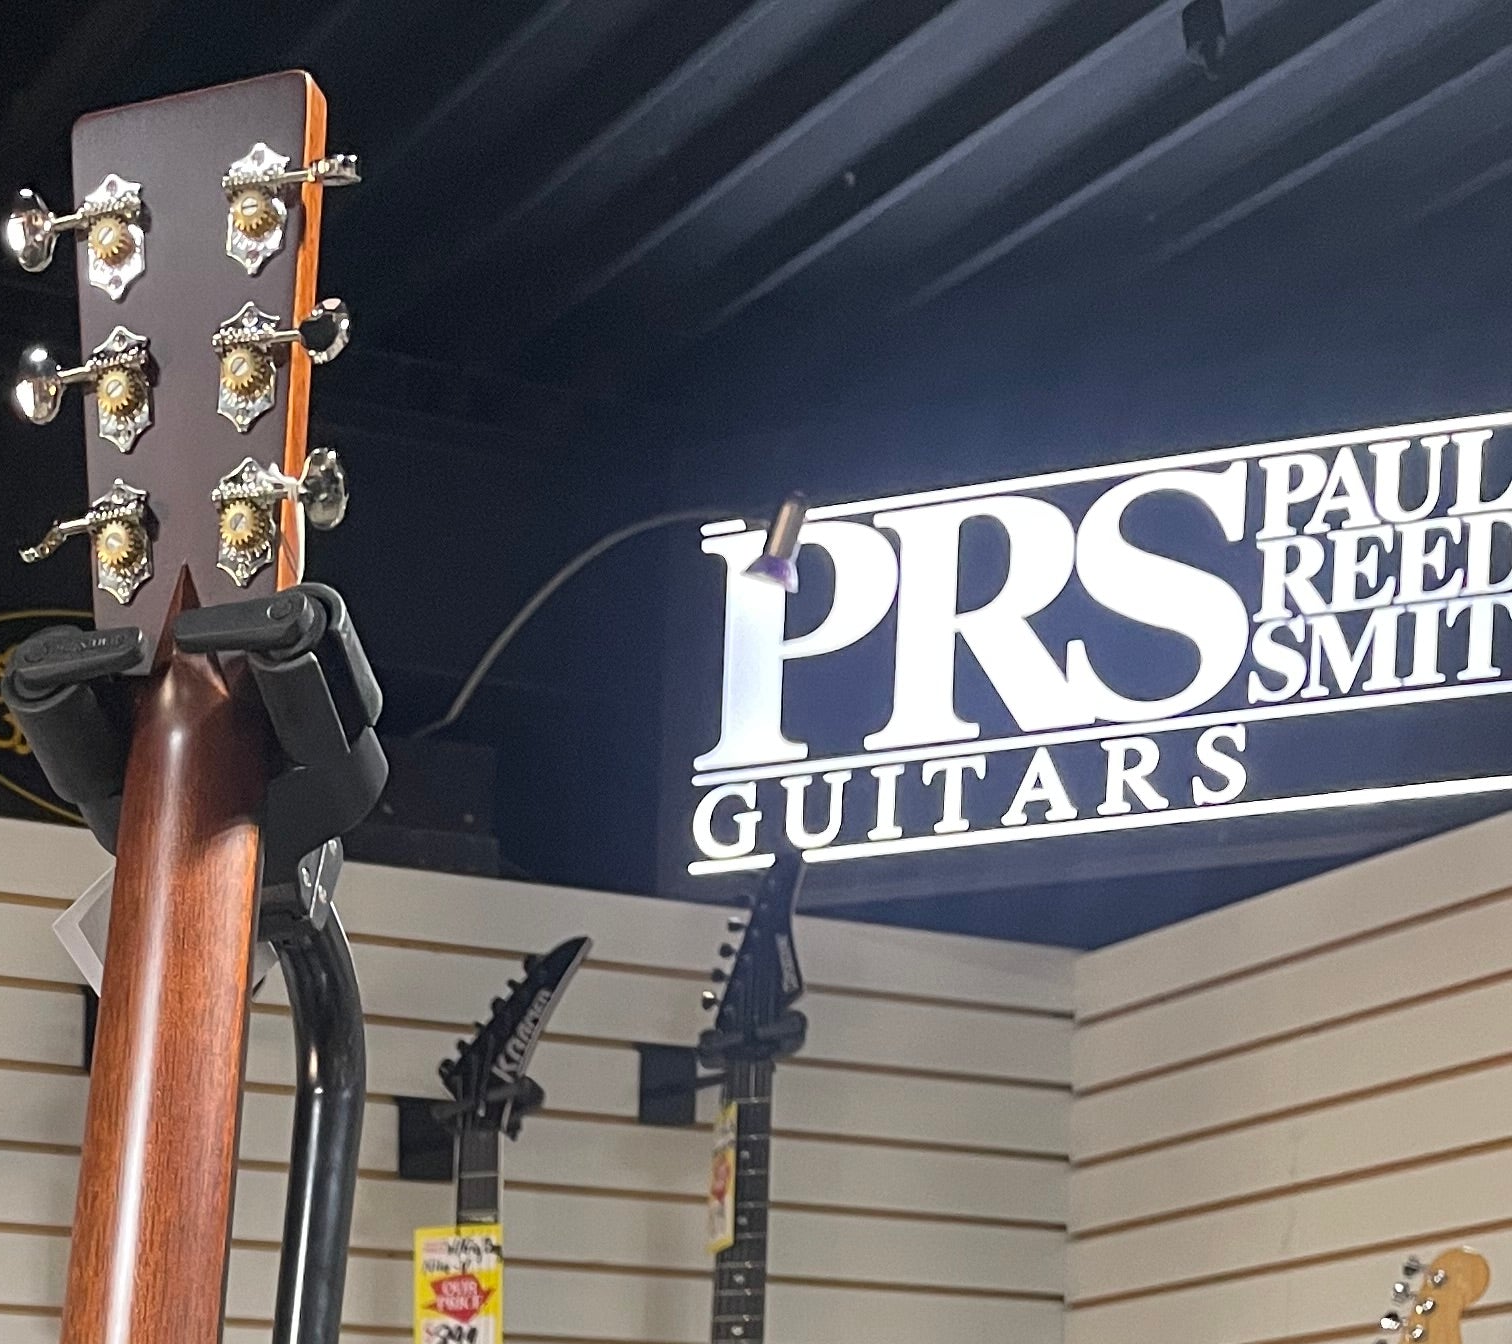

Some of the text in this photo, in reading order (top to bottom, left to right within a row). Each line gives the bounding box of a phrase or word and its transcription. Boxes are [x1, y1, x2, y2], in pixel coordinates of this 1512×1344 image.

[1256, 428, 1512, 541] PAUL
[694, 459, 1249, 770] PRS
[1256, 513, 1512, 623] REED
[691, 723, 1248, 861] GUITARS
